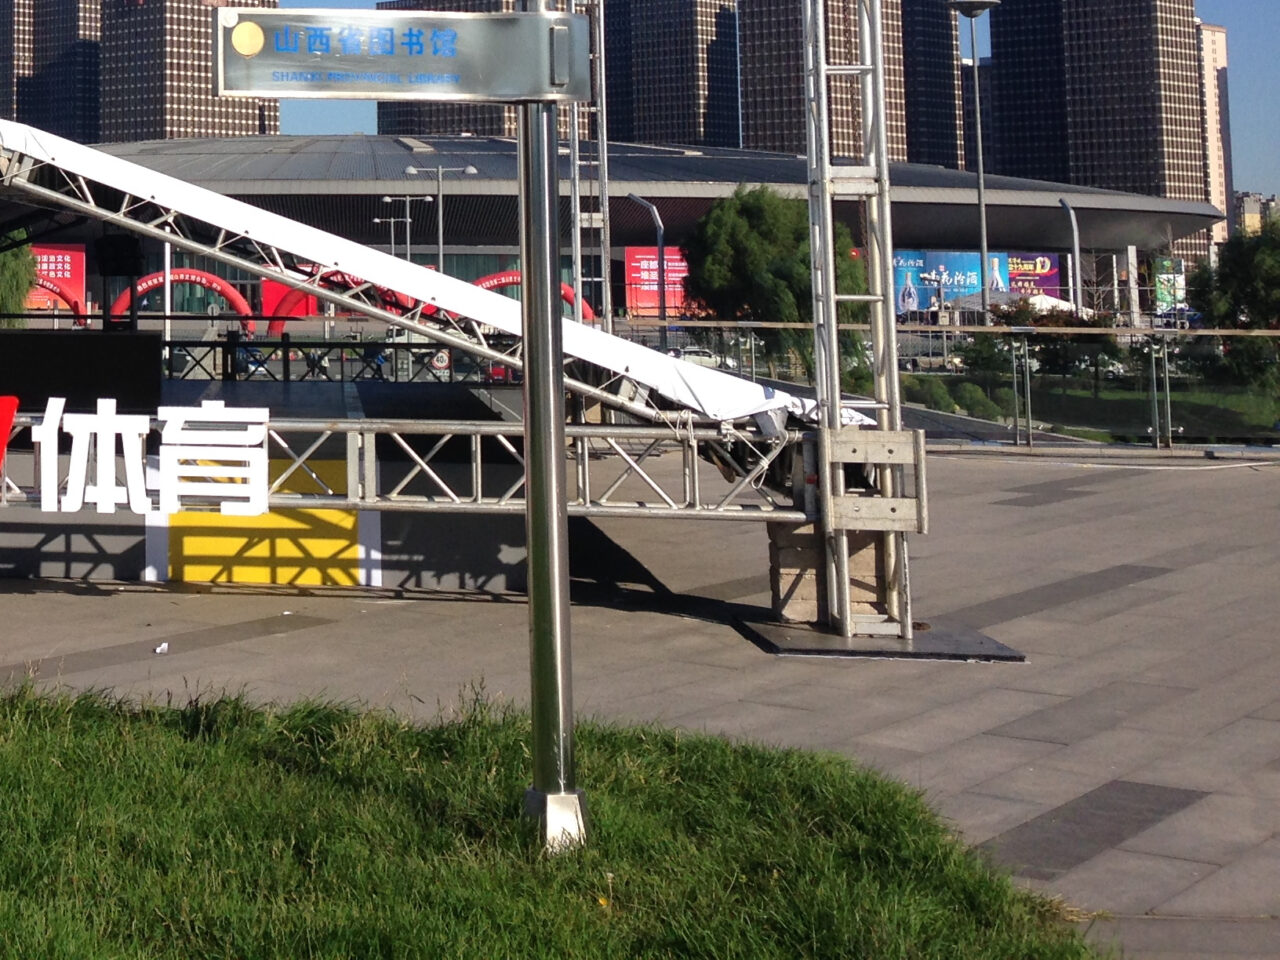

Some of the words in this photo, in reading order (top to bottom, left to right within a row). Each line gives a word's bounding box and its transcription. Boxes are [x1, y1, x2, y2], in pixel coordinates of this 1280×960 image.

[274, 25, 457, 57] 山西省图书馆
[327, 71, 401, 84] PROVINCIAL
[408, 72, 460, 84] LIBRARY
[32, 397, 270, 516] 体育
